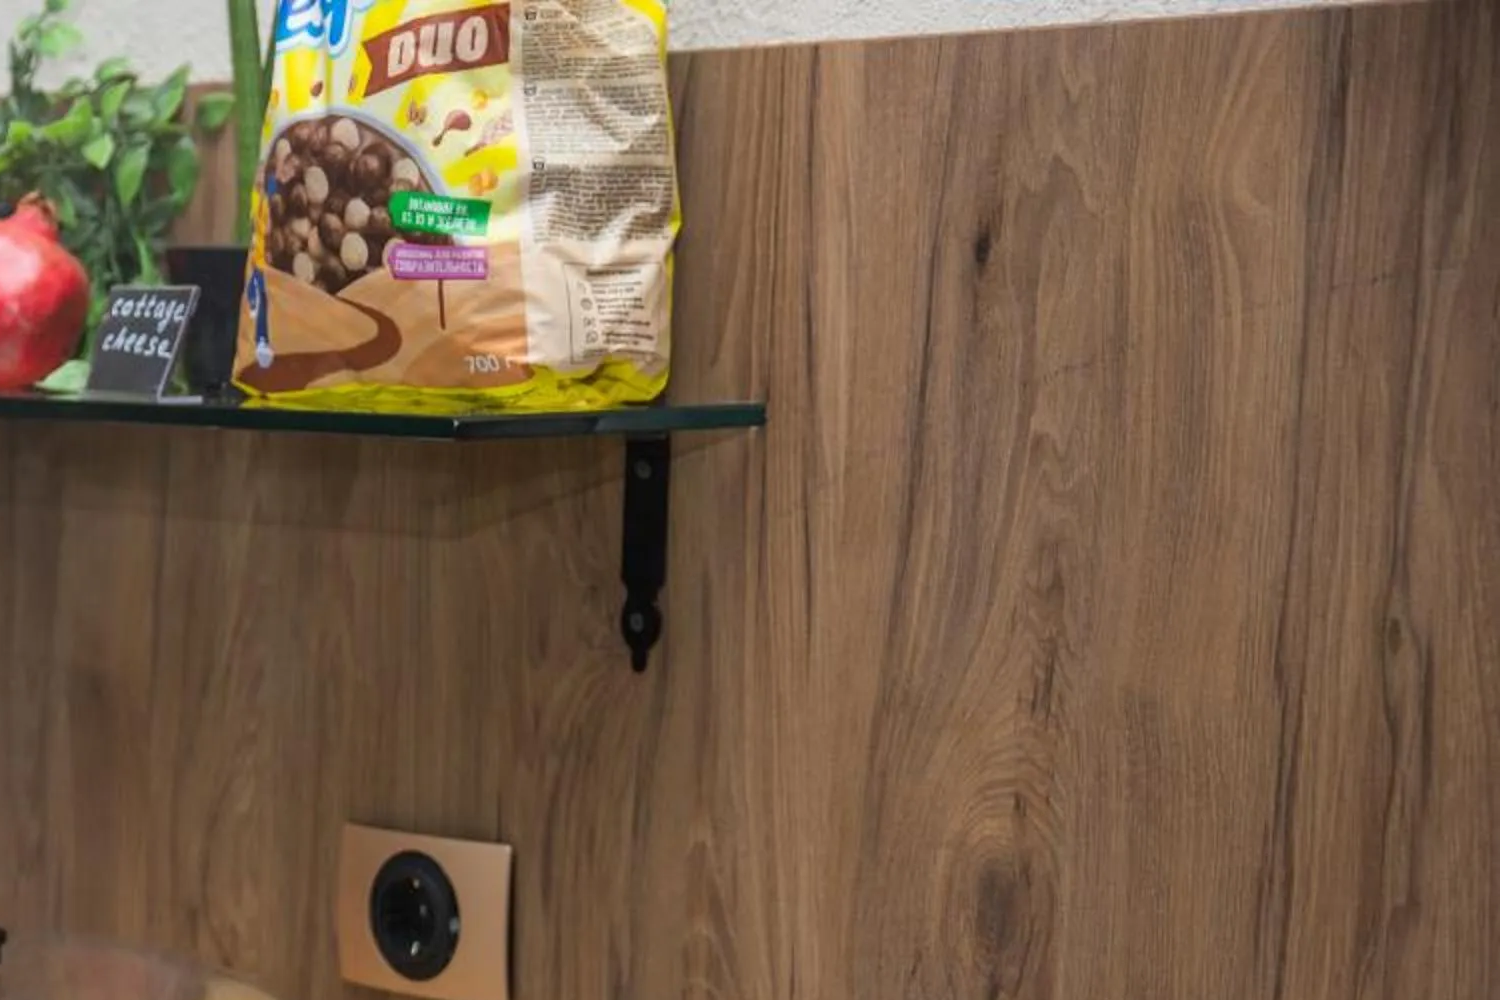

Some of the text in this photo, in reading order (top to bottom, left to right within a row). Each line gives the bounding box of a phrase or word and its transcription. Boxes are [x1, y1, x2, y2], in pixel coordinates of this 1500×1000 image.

[387, 15, 489, 79] DUO
[111, 293, 187, 334] cottage
[101, 326, 172, 358] cheese
[463, 353, 500, 375] 700
